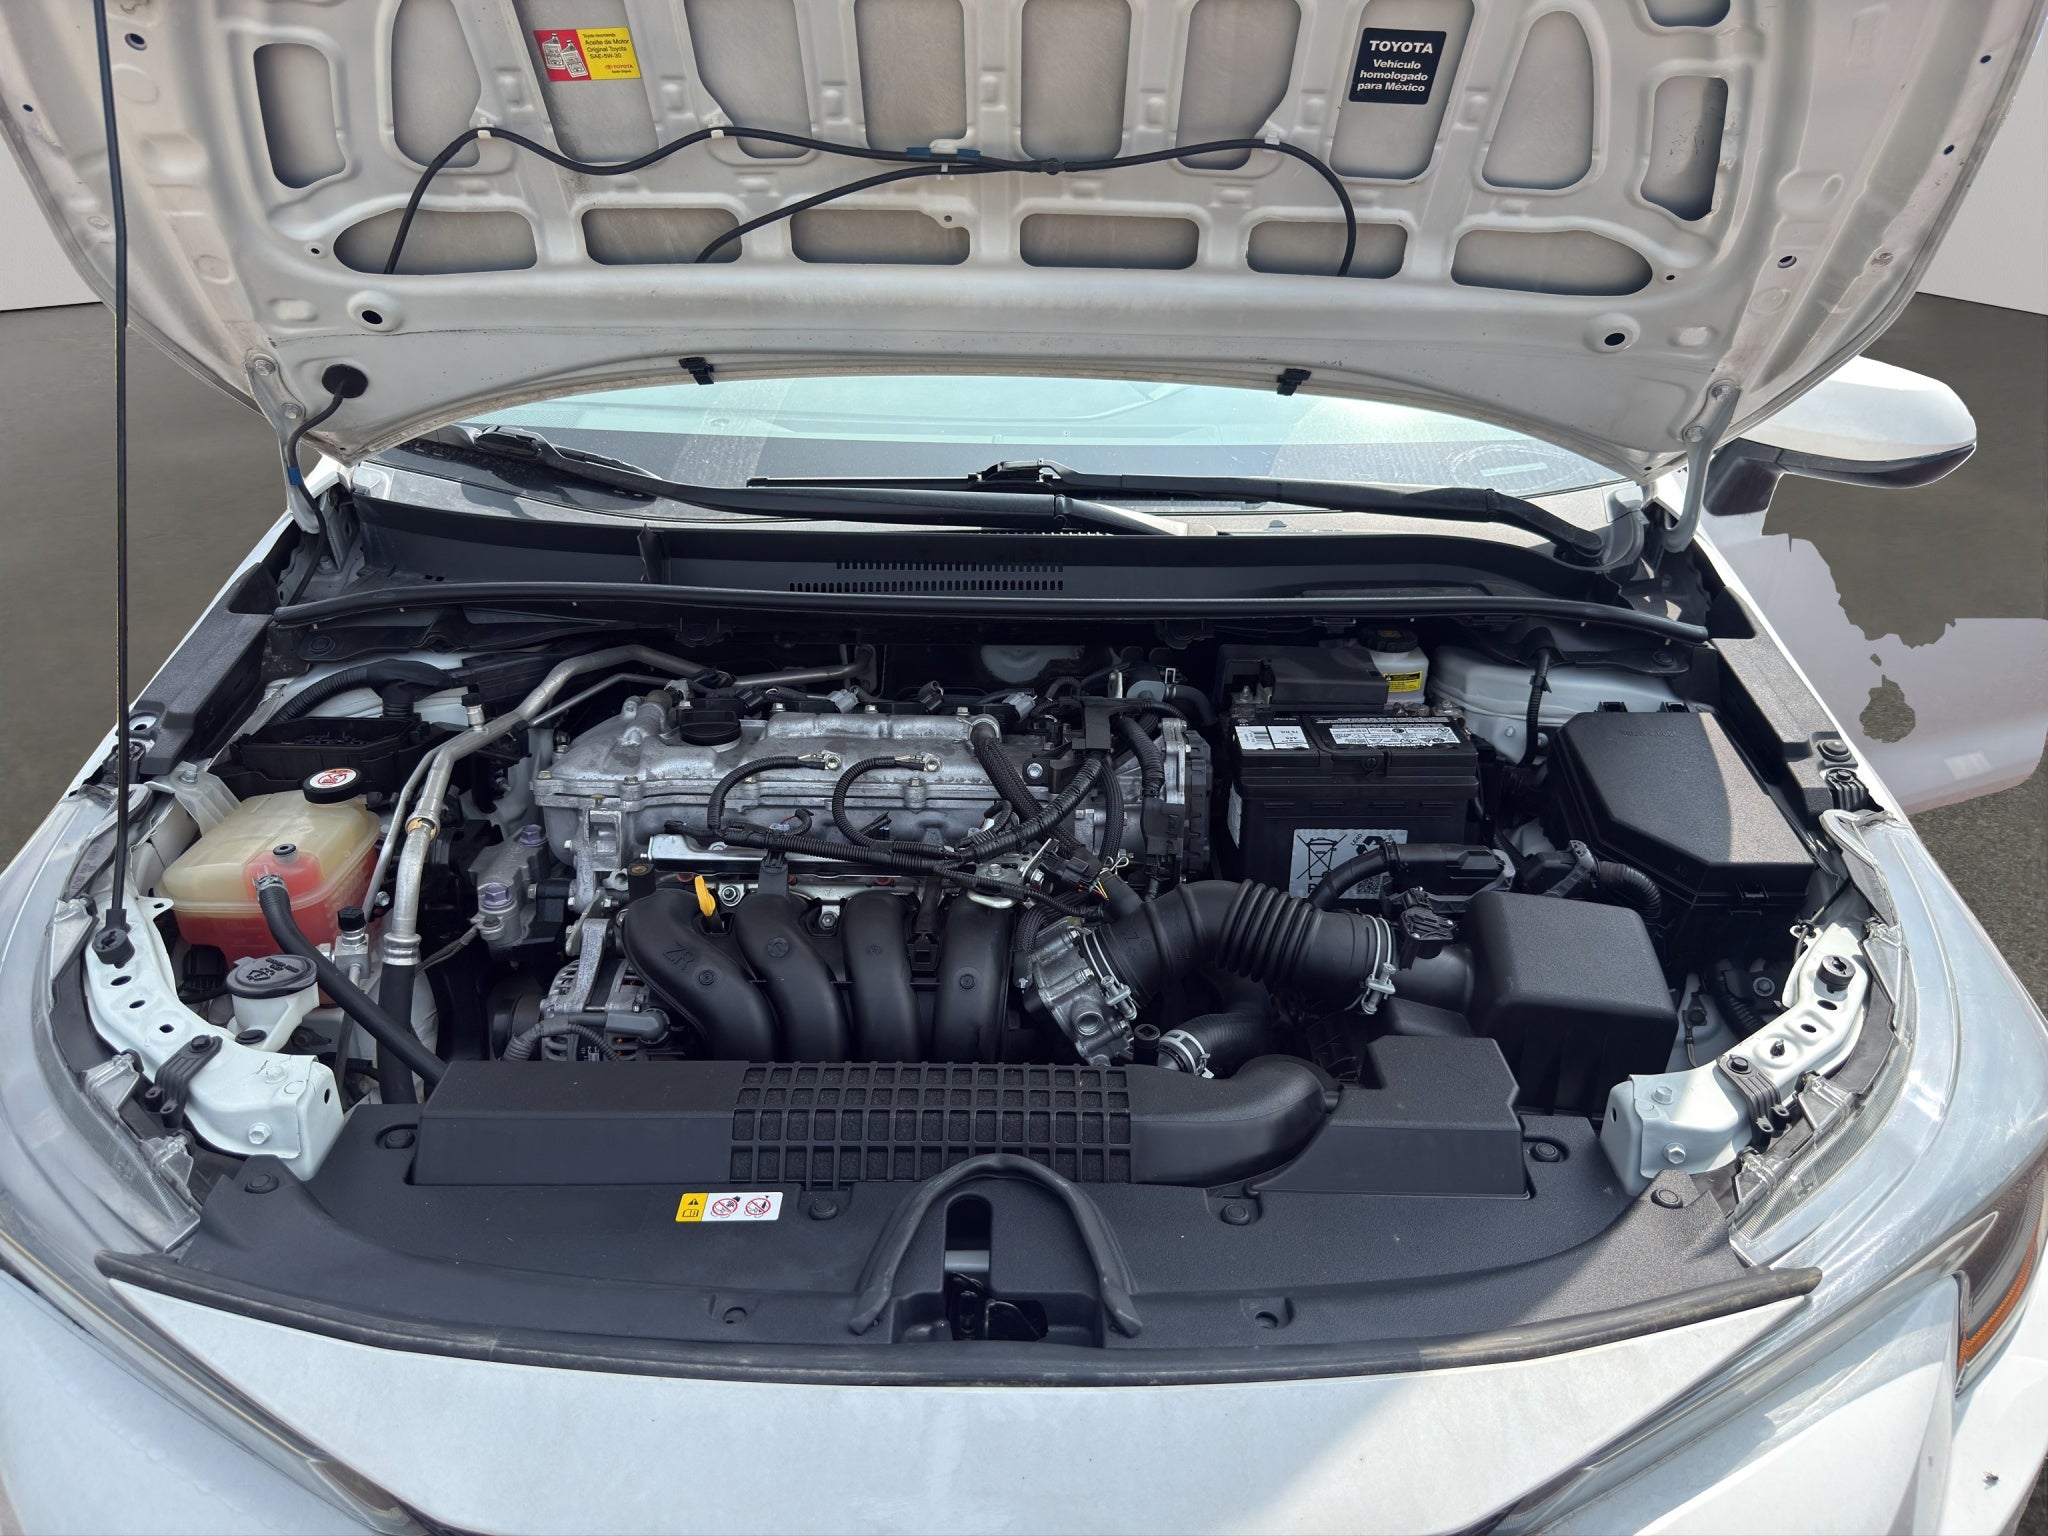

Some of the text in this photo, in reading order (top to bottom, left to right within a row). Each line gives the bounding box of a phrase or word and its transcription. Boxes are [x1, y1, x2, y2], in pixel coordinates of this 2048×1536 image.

[1369, 40, 1433, 54] TOYOTA
[1374, 59, 1421, 69] Vehículo
[1360, 70, 1428, 82] homologado
[1357, 82, 1425, 91] para México
[1350, 833, 1363, 846] LEAD
